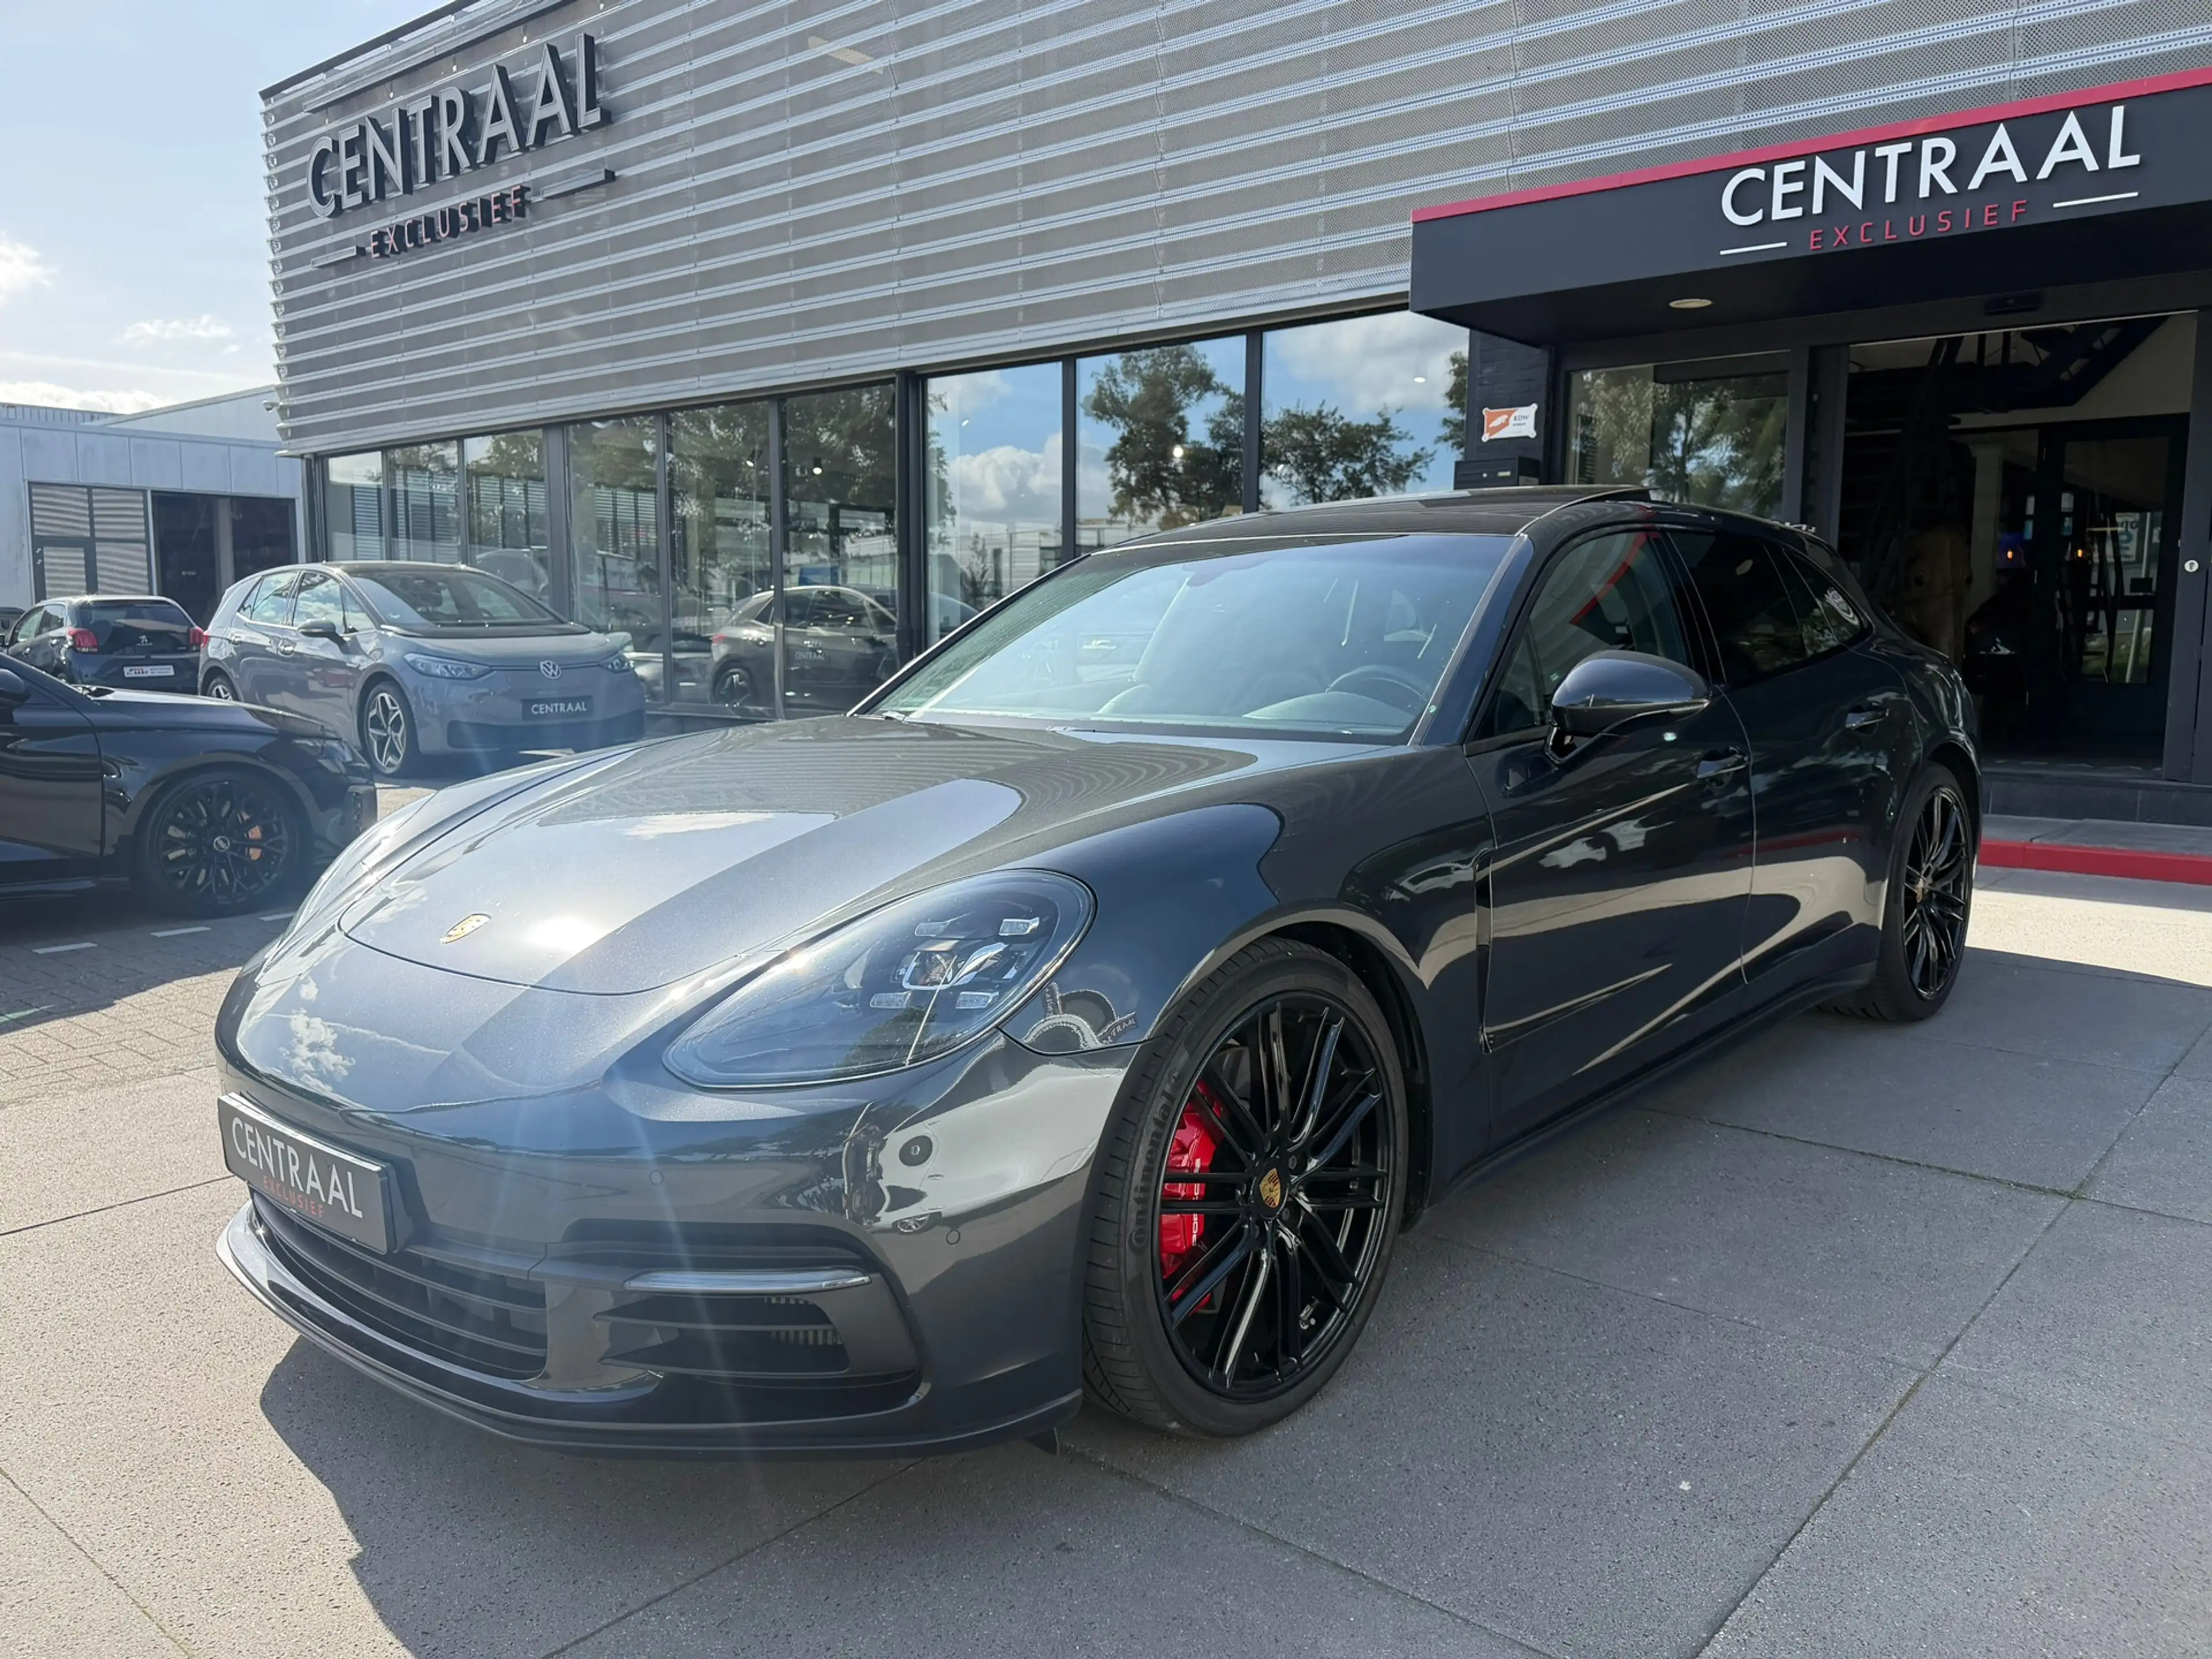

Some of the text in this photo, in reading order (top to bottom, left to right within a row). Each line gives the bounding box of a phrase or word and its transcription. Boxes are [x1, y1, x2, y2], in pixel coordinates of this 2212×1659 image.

[306, 33, 606, 218] CENTRAAL
[1720, 104, 2141, 226] CENTRAAL
[370, 184, 525, 259] EXCLUSIEF
[1809, 199, 2028, 251] EXCLUSIEF
[531, 701, 588, 715] CENTRAAL
[232, 1117, 363, 1219] CENTRAAL
[263, 1175, 325, 1218] EXCLUSIEF
[1128, 1089, 1175, 1256] Continental
